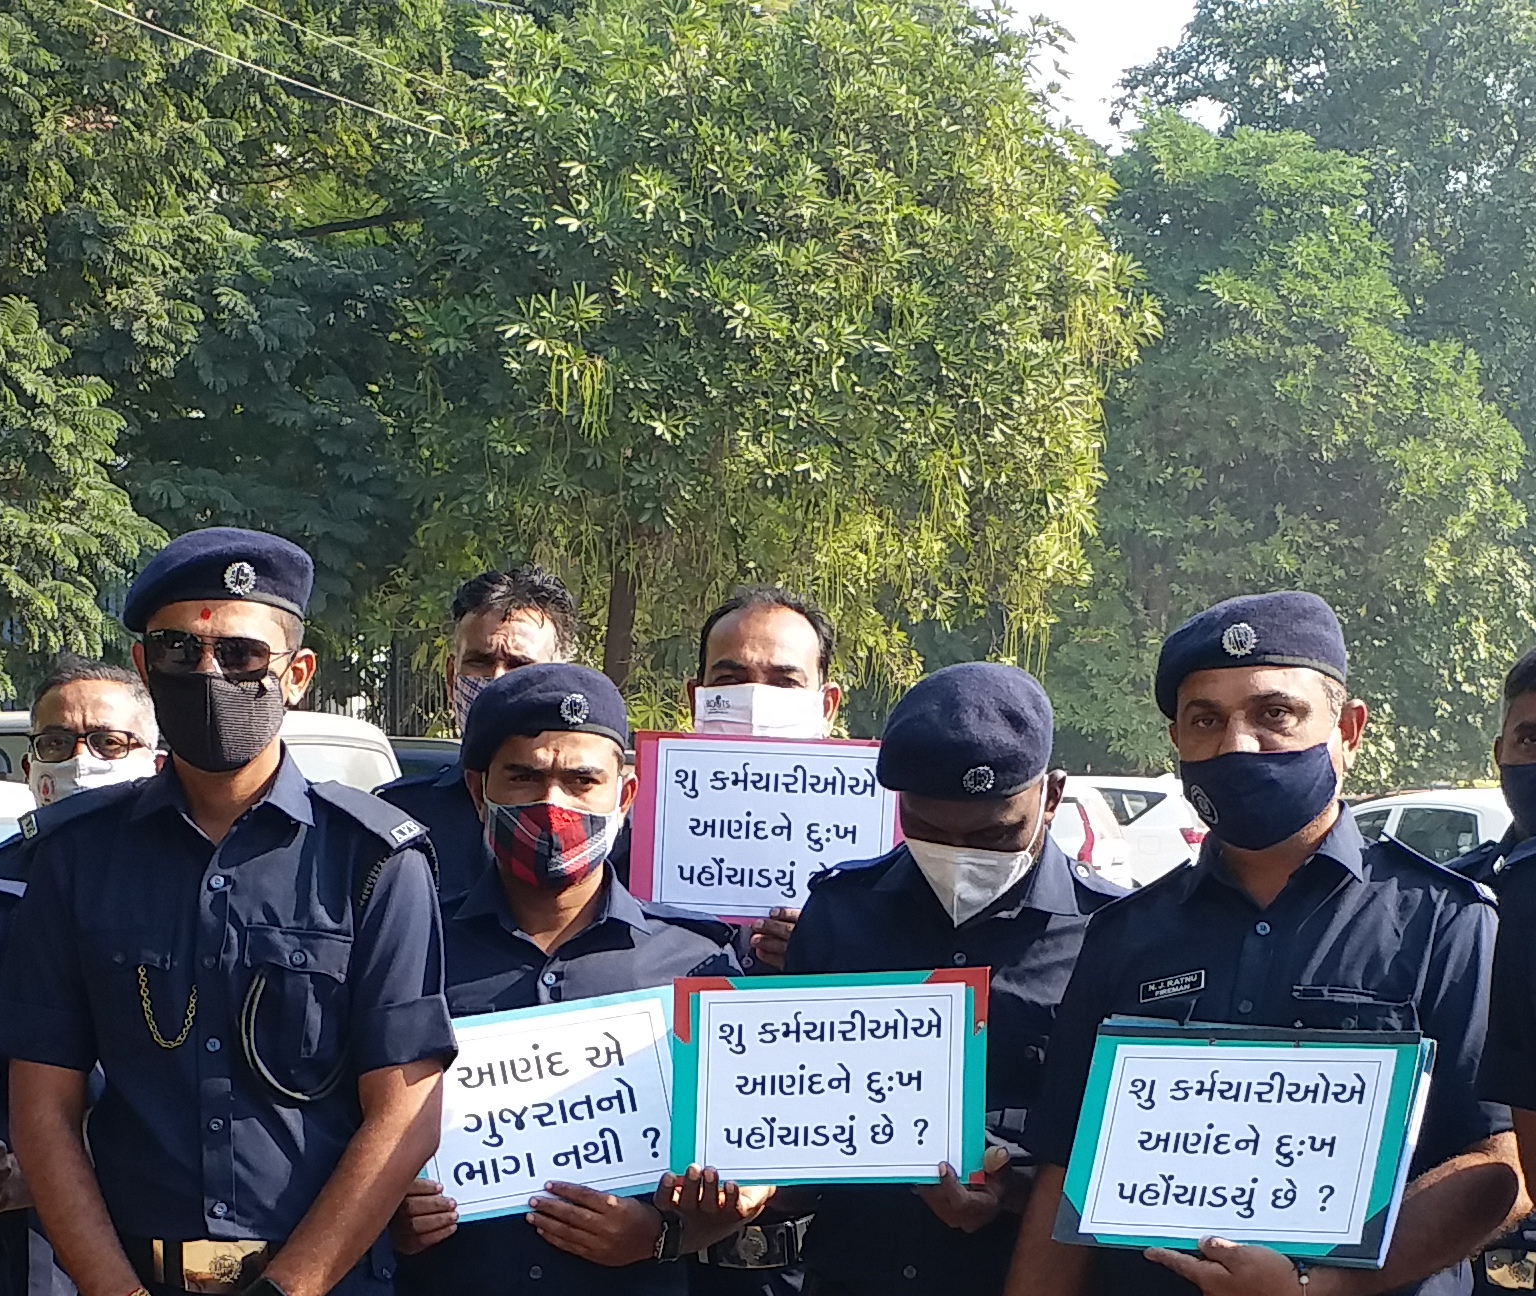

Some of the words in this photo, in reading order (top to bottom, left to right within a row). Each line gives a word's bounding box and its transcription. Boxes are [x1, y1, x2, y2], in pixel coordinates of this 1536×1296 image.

[675, 770, 698, 798] શુ
[710, 763, 877, 797] કર્મચારીઓએ
[689, 811, 791, 841] આણંદને
[1155, 984, 1190, 996] FIREMAN
[1167, 974, 1197, 987] RATNU
[719, 1024, 746, 1054] શુ
[758, 1008, 941, 1043] કર્મચારીઓએ
[454, 1041, 569, 1088] આણંદ
[585, 1032, 624, 1068] એ
[736, 1063, 850, 1095] આણંદને
[1129, 1079, 1155, 1110] શુ
[1170, 1070, 1365, 1104] કર્મચારીઓએ
[461, 1076, 637, 1150] ગુજરાતનો
[871, 1114, 893, 1144] છે
[914, 1119, 928, 1145] ?
[1138, 1123, 1259, 1155] આણંદને
[454, 1153, 535, 1186] ભાગ
[553, 1128, 623, 1169] નથી
[642, 1127, 660, 1158] ?
[1272, 1179, 1297, 1209] છે
[1319, 1185, 1334, 1211] ?
